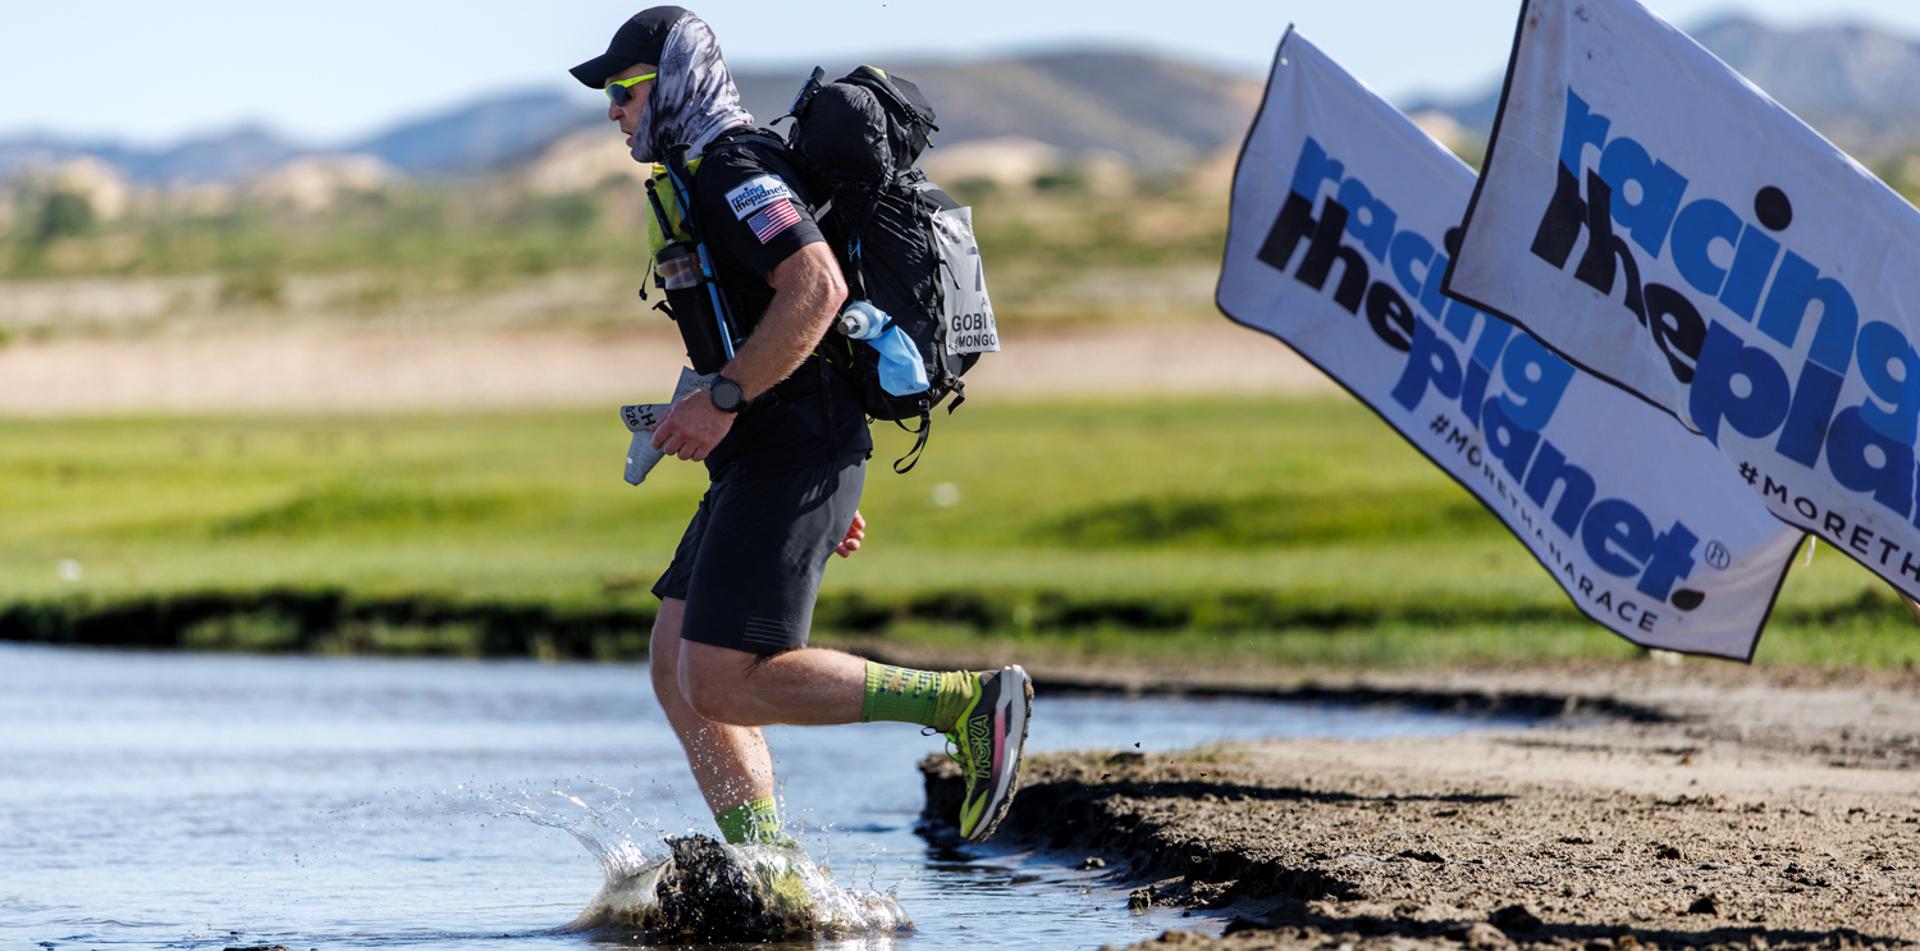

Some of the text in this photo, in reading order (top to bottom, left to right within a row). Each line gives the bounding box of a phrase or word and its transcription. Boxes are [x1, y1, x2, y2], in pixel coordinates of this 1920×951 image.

[1559, 86, 1920, 446] racing
[951, 312, 987, 333] GOBI
[969, 714, 991, 779] HOKA
